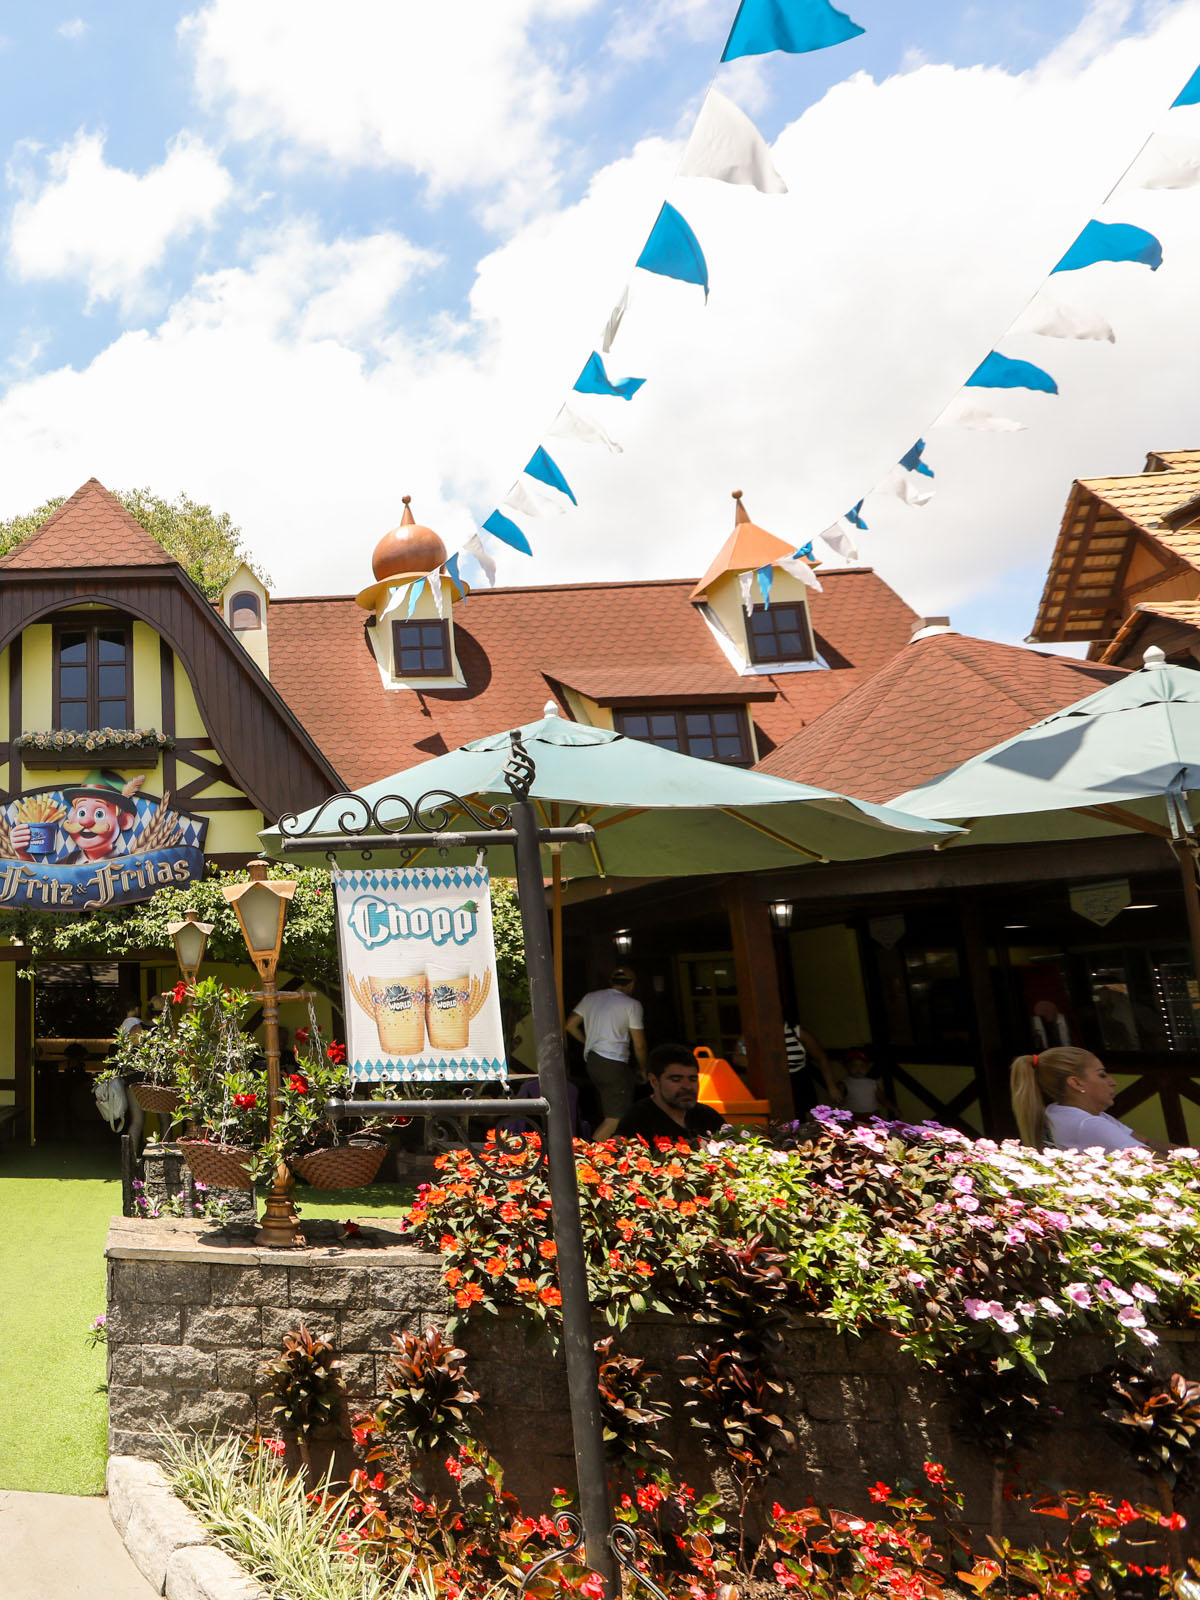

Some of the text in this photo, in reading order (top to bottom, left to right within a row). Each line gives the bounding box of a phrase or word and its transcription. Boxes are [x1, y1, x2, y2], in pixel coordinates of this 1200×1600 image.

[77, 883, 87, 895] &
[83, 860, 191, 911] Fritas
[349, 895, 475, 948] Chopp
[388, 1001, 412, 1010] WORLD
[435, 1000, 457, 1009] WORLD
